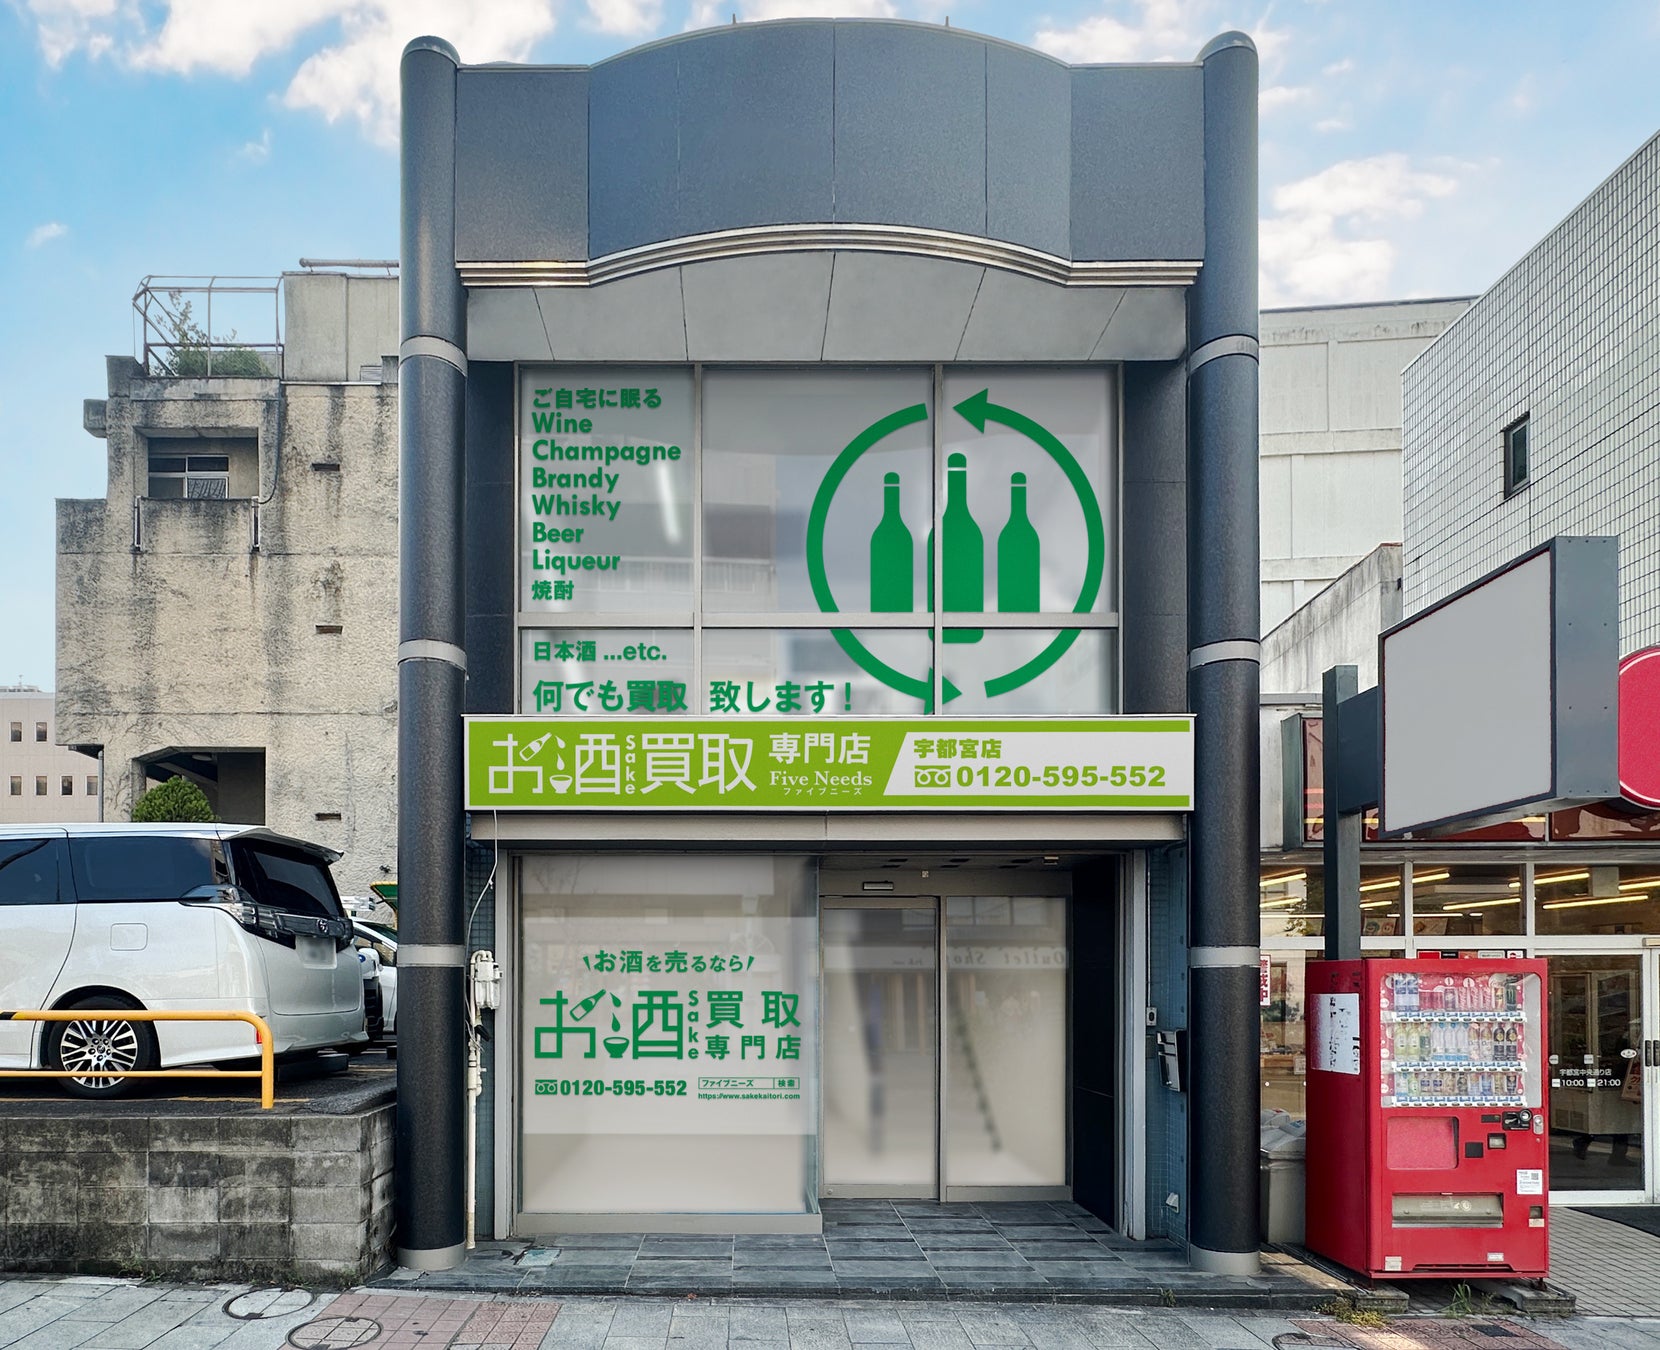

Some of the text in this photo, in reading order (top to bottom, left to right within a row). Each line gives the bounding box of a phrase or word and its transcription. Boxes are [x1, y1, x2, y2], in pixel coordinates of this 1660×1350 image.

[533, 388, 662, 409] ご自宅に眠る
[532, 412, 593, 433] Wine
[532, 439, 682, 465] Champagne
[532, 466, 619, 493] Brandy
[532, 494, 621, 517] Whisky
[532, 522, 585, 543] Beer
[532, 549, 621, 575] Liqueur
[531, 580, 575, 601] 焼酎
[533, 640, 597, 662] 日本酒
[533, 680, 689, 712] 何でも買取
[769, 732, 871, 764] 専門店
[913, 738, 1003, 759] 宇都宮店
[769, 770, 873, 786] Five Needs
[956, 766, 1166, 787] 0120-595-552
[783, 787, 863, 796] ファイブニーズ
[593, 950, 744, 973] お酒を売るなら
[704, 1034, 801, 1061] 専門店
[559, 1079, 687, 1096] 0120-595-552
[702, 1079, 754, 1087] ファイブニーズ
[1561, 1079, 1585, 1087] 10:00
[1597, 1079, 1621, 1087] 21:00
